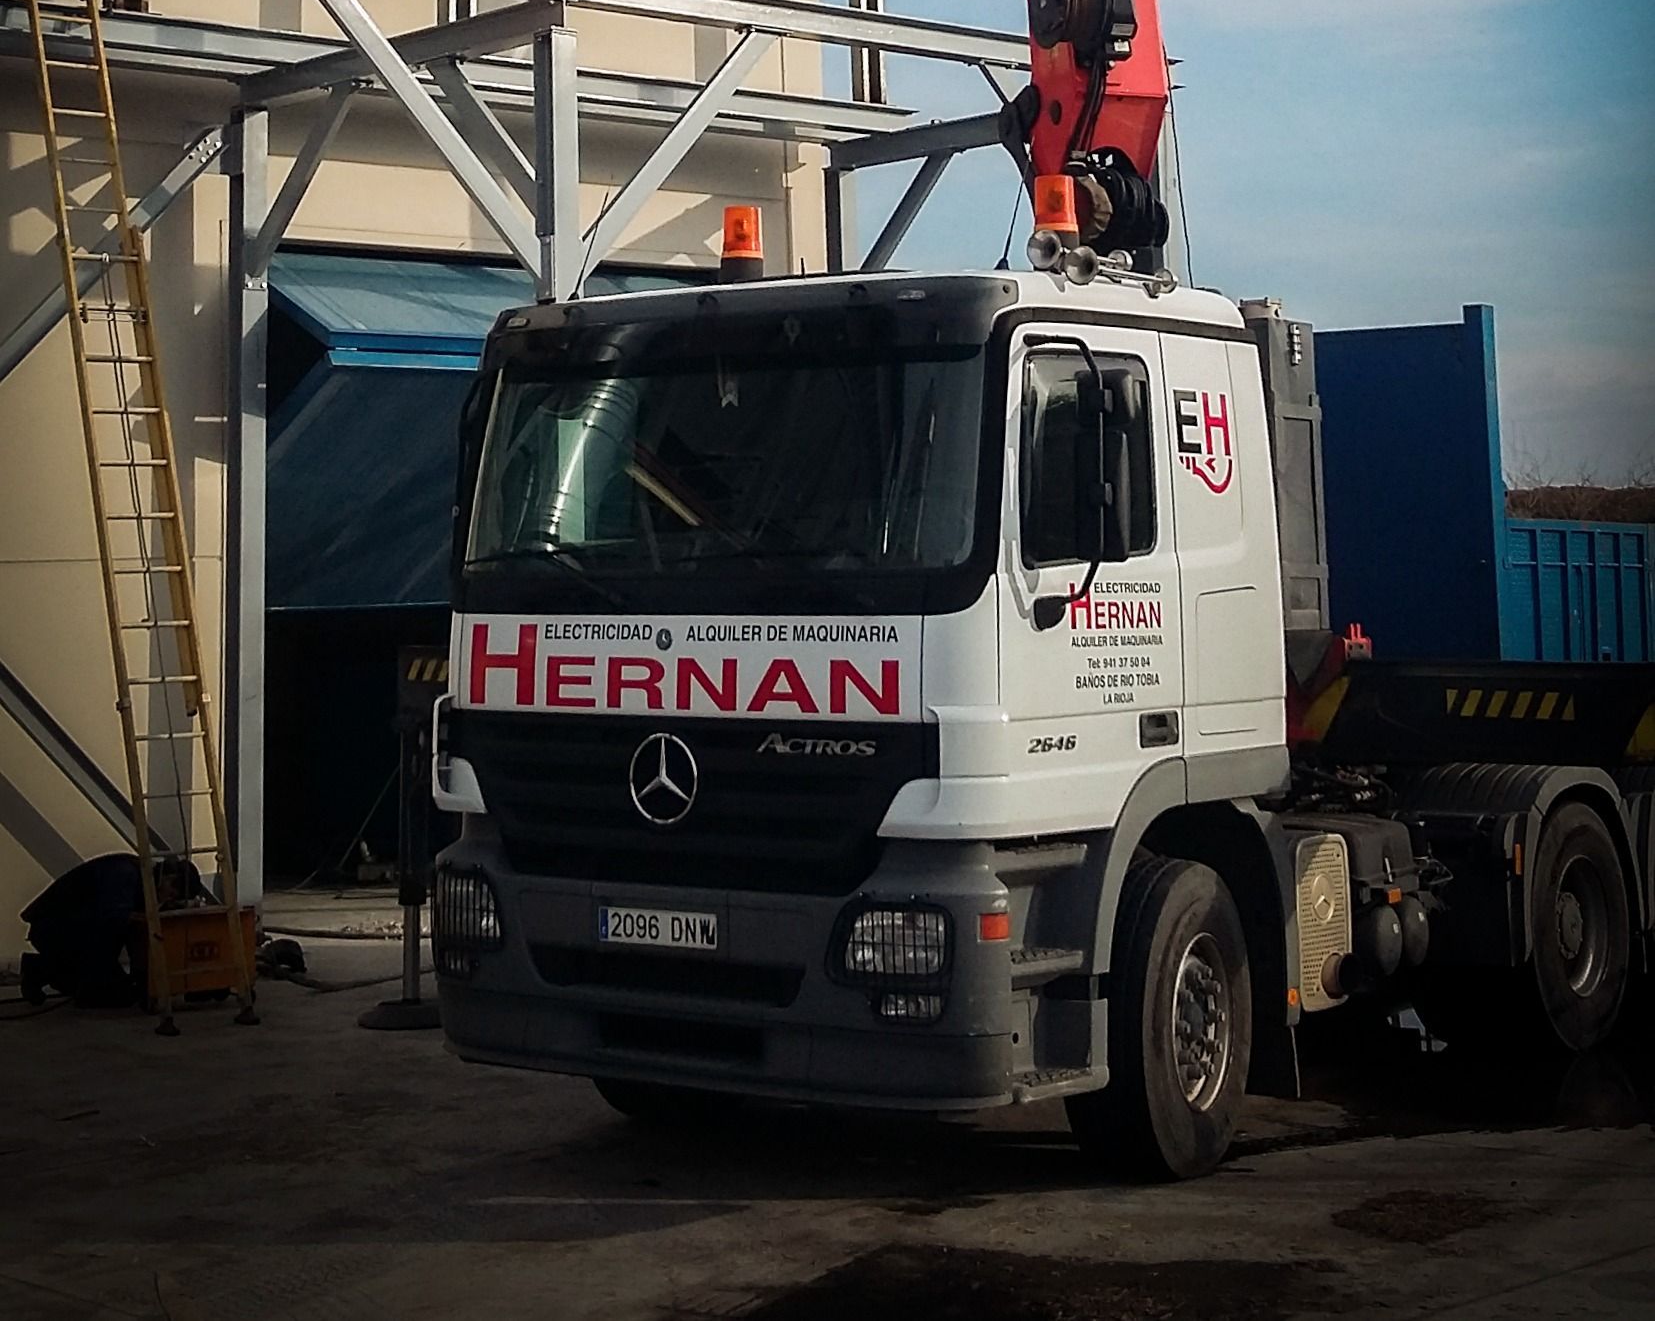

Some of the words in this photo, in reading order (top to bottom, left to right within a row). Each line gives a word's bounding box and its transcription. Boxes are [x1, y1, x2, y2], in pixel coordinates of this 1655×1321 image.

[1173, 389, 1231, 457] EH
[1094, 582, 1161, 593] ELECTRICIDAD
[1069, 582, 1162, 630] HERNAN
[544, 623, 653, 640] ELECTRICIDAD
[686, 625, 762, 641] ALQUILER
[766, 625, 788, 641] DE
[792, 625, 899, 643] MAQUINARIA
[1071, 636, 1108, 647] ALQUILER
[1109, 636, 1119, 646] DE
[1120, 635, 1163, 646] MAQUINARIA
[470, 623, 900, 715] HERNAN
[1103, 658, 1117, 668] 941
[1118, 657, 1128, 668] 37
[1129, 657, 1140, 668] 50
[1075, 671, 1106, 689] BAÑOS
[1107, 674, 1119, 688] DE
[1103, 693, 1113, 705] LA
[1113, 692, 1134, 703] RIOJA
[1027, 734, 1077, 754] 2646
[610, 912, 660, 940] 2096
